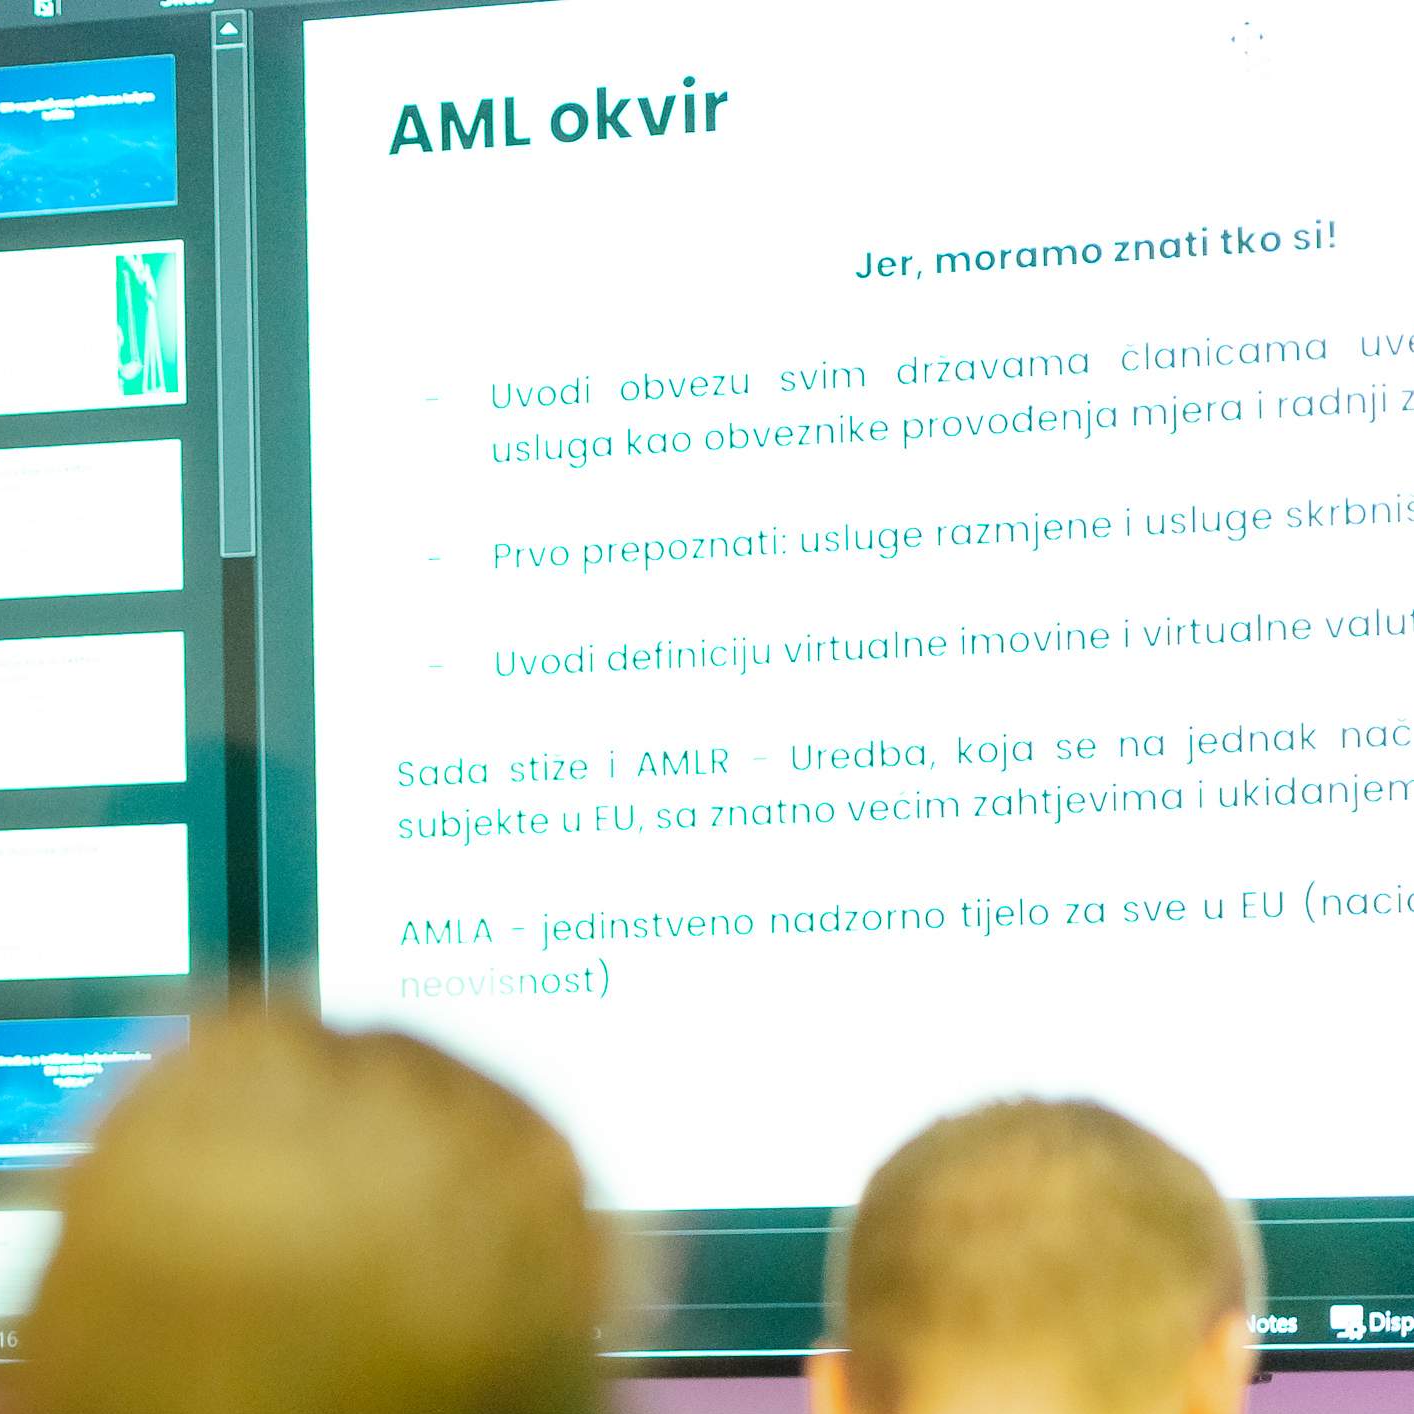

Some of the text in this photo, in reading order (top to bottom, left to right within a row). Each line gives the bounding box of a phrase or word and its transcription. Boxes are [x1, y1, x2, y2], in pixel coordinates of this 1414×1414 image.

[387, 74, 730, 157] AML okvir
[854, 218, 1336, 281] Jer, moramo znati tko si!
[491, 375, 591, 410] Uvodi
[619, 372, 749, 402] obvezu
[778, 360, 866, 393] svim
[1361, 334, 1414, 358] uv
[491, 432, 613, 470] usluga
[627, 426, 692, 457] kao
[704, 414, 890, 452] obveznike
[1132, 395, 1242, 436] mjera
[1257, 389, 1263, 420] i
[1278, 383, 1387, 424] radnji
[493, 542, 571, 570] Prvo
[582, 525, 787, 576] prepoznati:
[799, 522, 923, 560] usluge
[936, 512, 1113, 553] razmjene
[1125, 507, 1131, 537] i
[1145, 504, 1273, 542] usluge
[495, 643, 594, 678] Uvodi
[607, 636, 771, 676] definiciju
[783, 629, 948, 665] virtualne
[959, 621, 1111, 657] imovine
[1123, 618, 1129, 649] i
[1142, 613, 1312, 648] virtualne
[396, 756, 488, 789] Sada
[609, 749, 615, 779] i
[636, 747, 730, 778] AMLR
[791, 739, 936, 772] Uredba,
[957, 733, 1034, 773] koja
[1056, 737, 1097, 761] se
[1119, 735, 1165, 758] na
[1186, 721, 1317, 766] jednak
[397, 806, 549, 848] subjekte
[562, 811, 581, 833] u
[595, 803, 644, 834] EU,
[655, 807, 697, 830] sa
[710, 799, 836, 827] znatno
[973, 783, 1183, 825] zahtjevima
[1198, 779, 1204, 809] i
[399, 917, 493, 946] AMLA
[541, 911, 755, 952] jedinstveno
[770, 903, 946, 935] nadzorno
[960, 895, 1050, 938] tijelo
[1064, 901, 1105, 926] za
[1123, 898, 1188, 924] sve
[1203, 898, 1224, 921] u
[1241, 890, 1284, 919] EU
[399, 956, 612, 1001] neovisnost)
